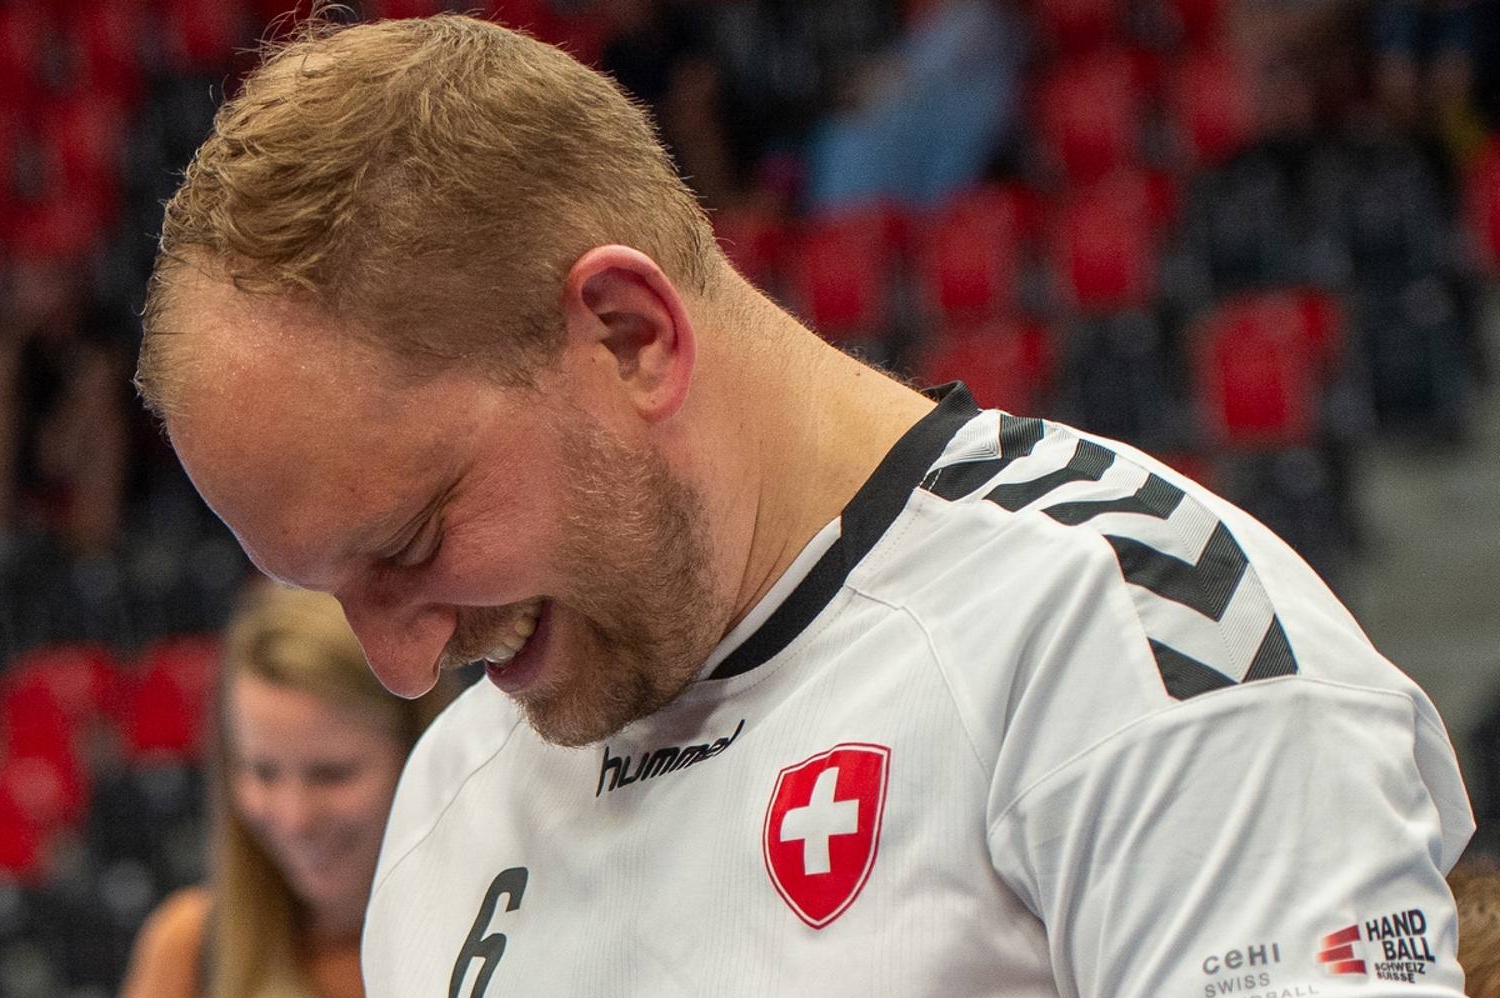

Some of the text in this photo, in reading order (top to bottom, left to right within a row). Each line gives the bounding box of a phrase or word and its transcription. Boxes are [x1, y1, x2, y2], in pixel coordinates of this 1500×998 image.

[596, 719, 745, 797] hummel
[1366, 909, 1427, 941] HAND
[1382, 937, 1436, 962] BALL
[1374, 962, 1426, 975] SCHWEIZ
[1377, 971, 1415, 984] SUISSE
[1204, 972, 1271, 998] SWISS
